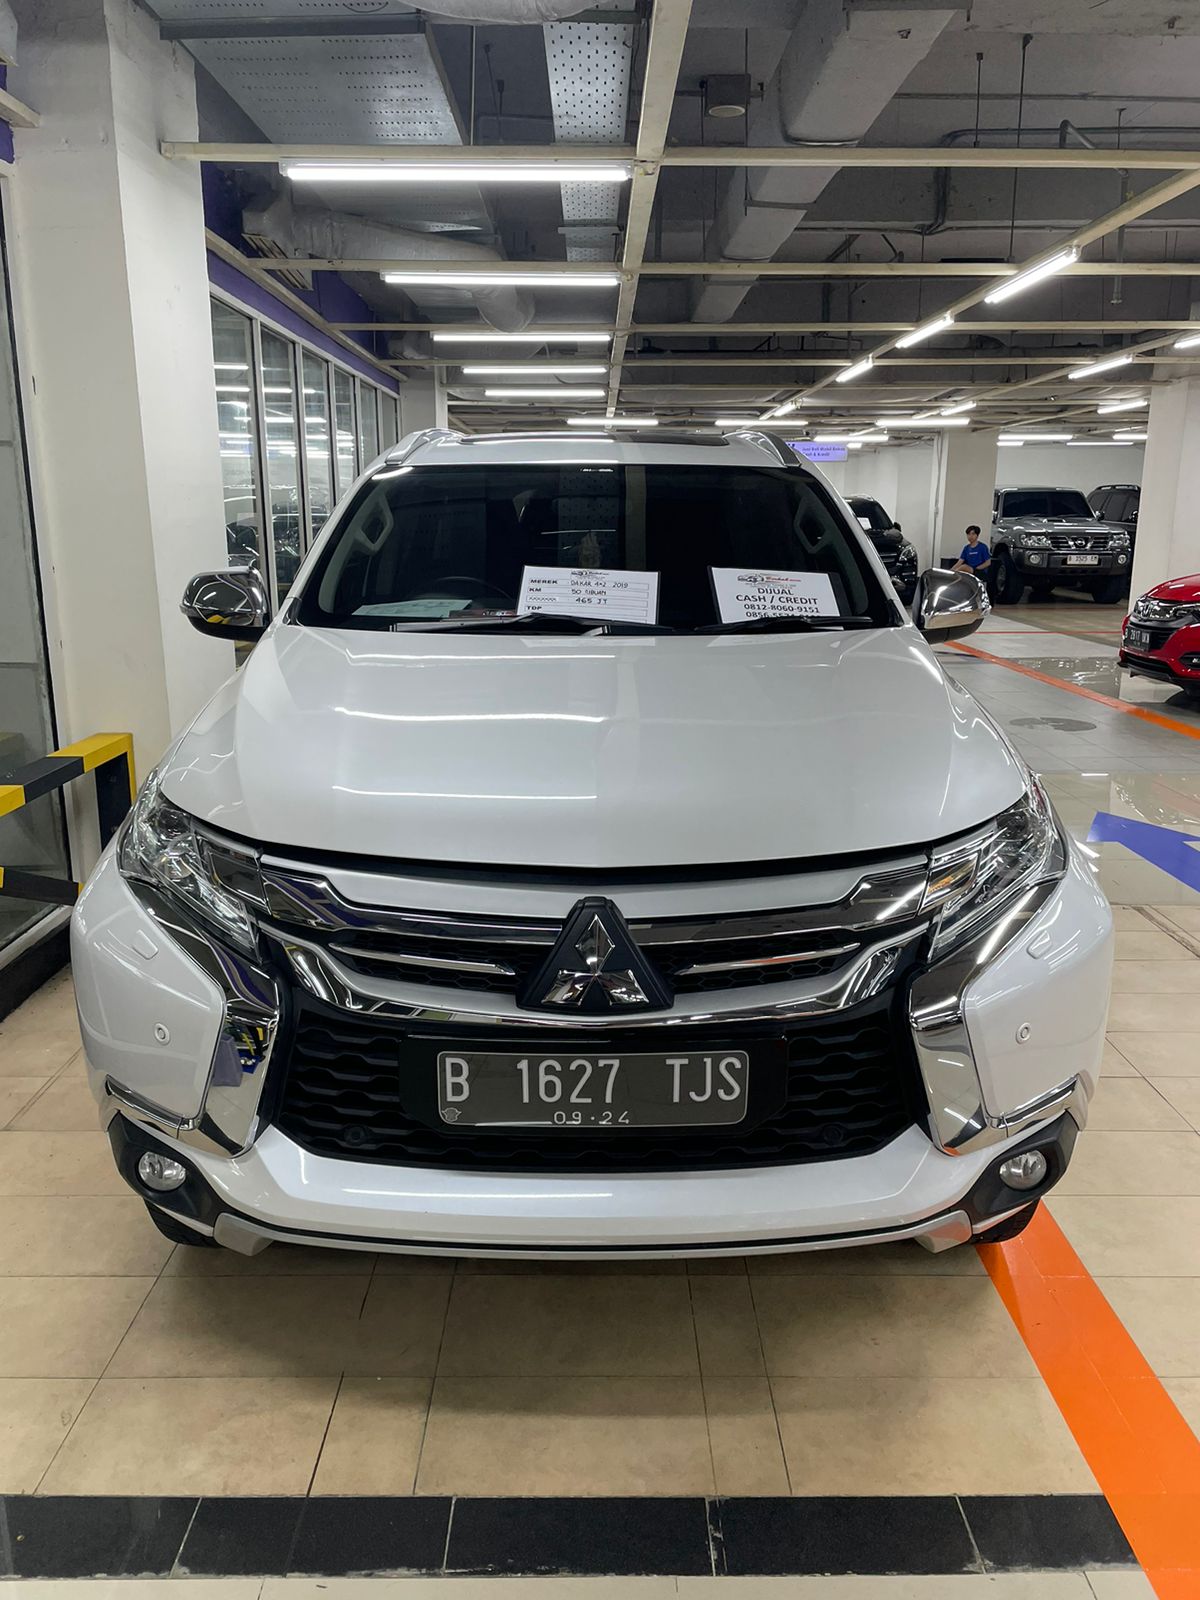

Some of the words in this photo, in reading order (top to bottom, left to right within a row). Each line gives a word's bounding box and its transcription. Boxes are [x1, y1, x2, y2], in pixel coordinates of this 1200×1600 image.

[612, 581, 628, 589] 2019
[757, 588, 794, 596] DIJUAL
[736, 594, 766, 602] CASH
[778, 596, 818, 605] CREDIT
[445, 1057, 470, 1102] B
[516, 1058, 621, 1104] 1627
[665, 1056, 742, 1103] TJS
